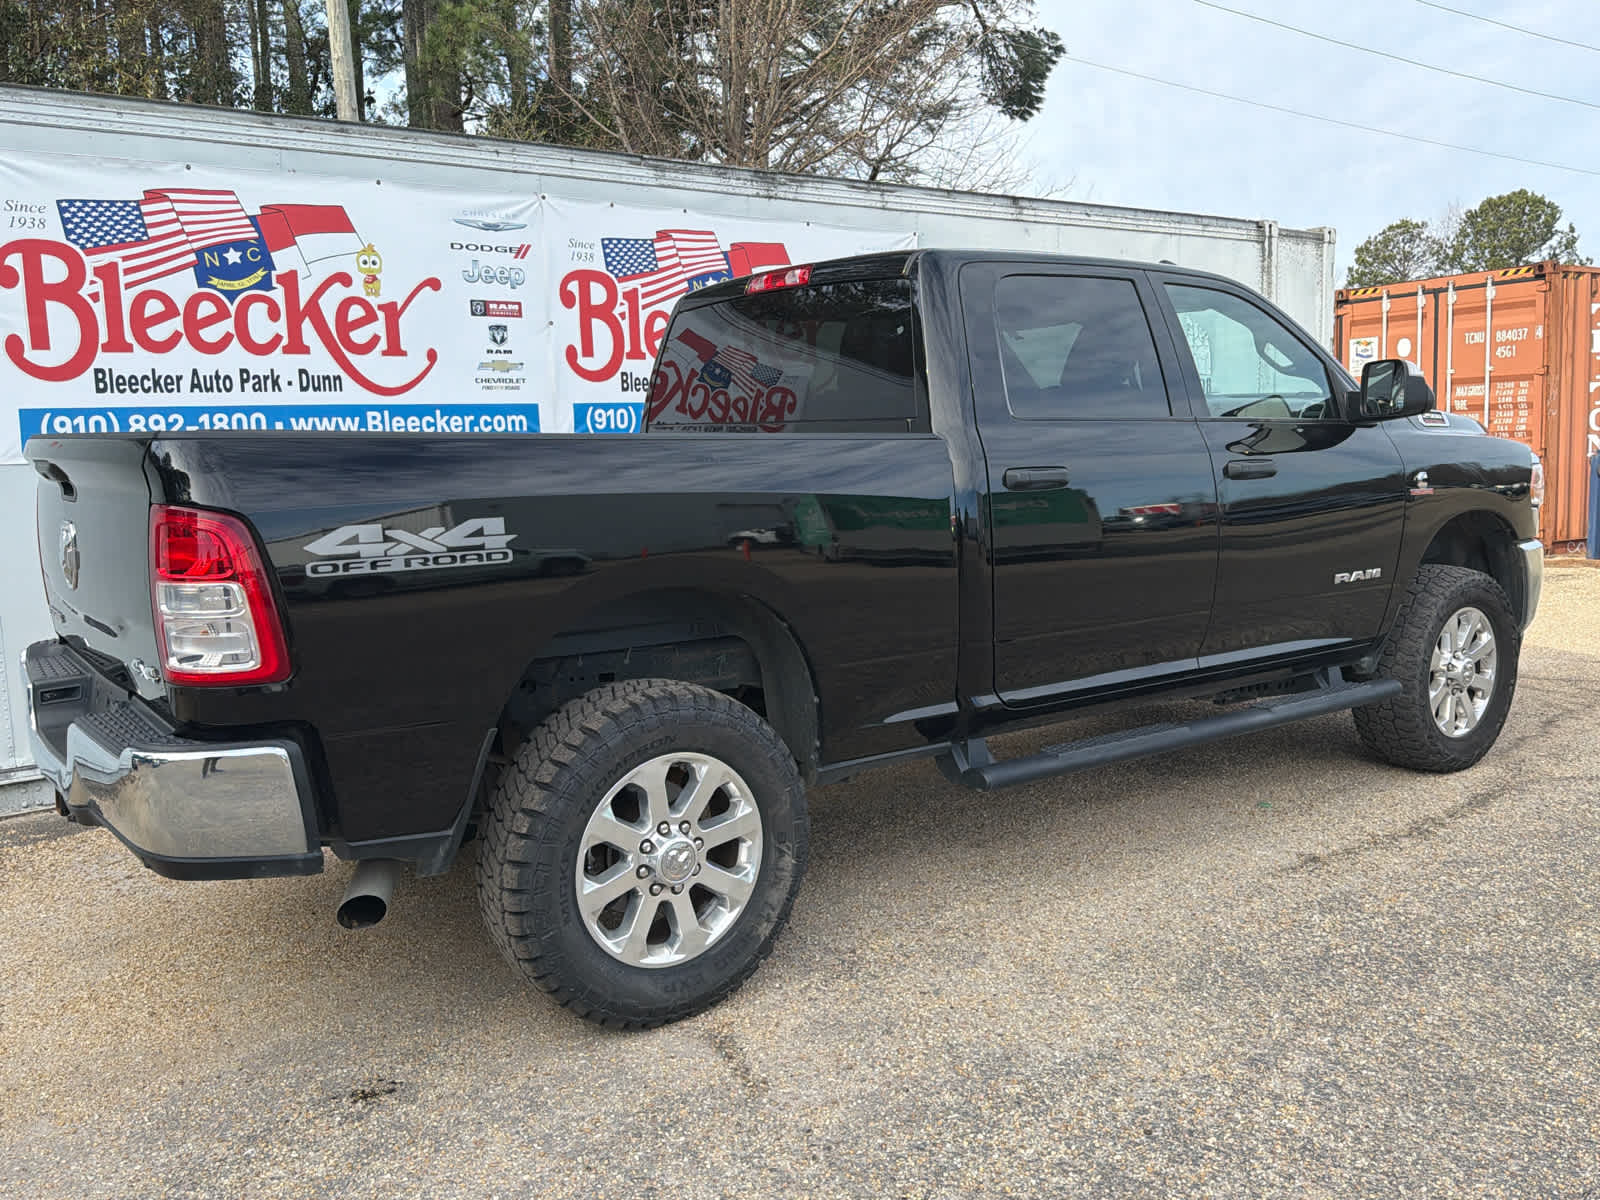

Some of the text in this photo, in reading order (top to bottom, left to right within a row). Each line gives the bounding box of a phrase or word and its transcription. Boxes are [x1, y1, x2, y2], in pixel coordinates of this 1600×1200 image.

[3, 199, 48, 215] Since
[8, 216, 47, 230] 1938
[450, 242, 521, 254] DODGE
[568, 238, 595, 250] Since
[570, 251, 594, 263] 1938
[462, 259, 526, 290] Jeep
[488, 303, 520, 311] RAM
[1464, 331, 1485, 345] TCNU
[1495, 327, 1528, 343] 884037
[1495, 345, 1516, 359] 45G1
[94, 368, 343, 394] Bleecker Auto Park Dunn
[40, 410, 528, 434] (910) 892-1800 www.Bleecker.com
[586, 405, 637, 434] (910)
[310, 551, 511, 575] OFF ROAD
[1334, 567, 1382, 584] RAM
